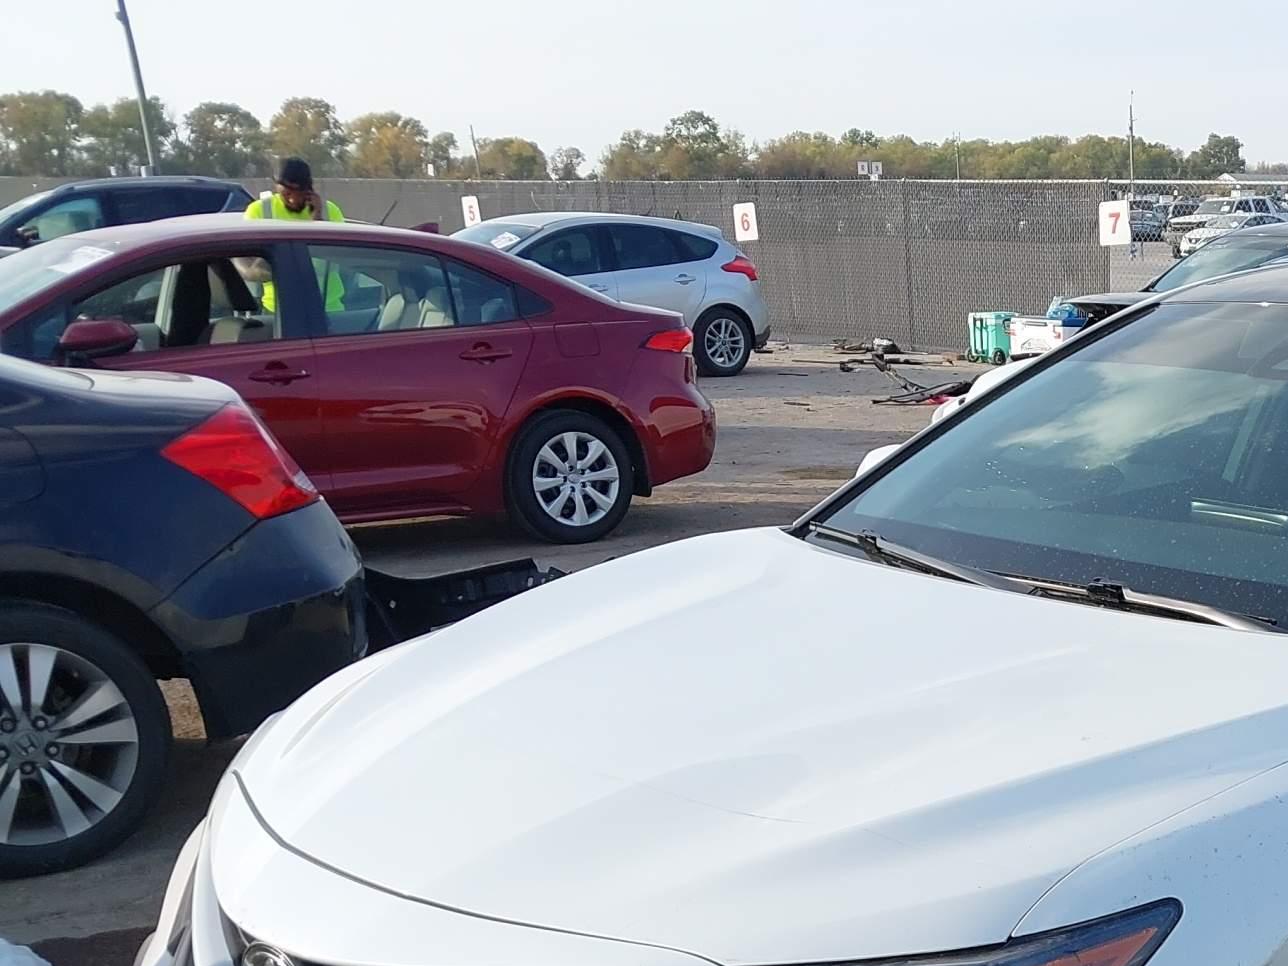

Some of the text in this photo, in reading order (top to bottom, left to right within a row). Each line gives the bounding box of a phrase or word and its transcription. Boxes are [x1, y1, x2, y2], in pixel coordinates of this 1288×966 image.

[468, 204, 476, 221] 5
[741, 212, 750, 231] 6
[1108, 211, 1121, 234] 7
